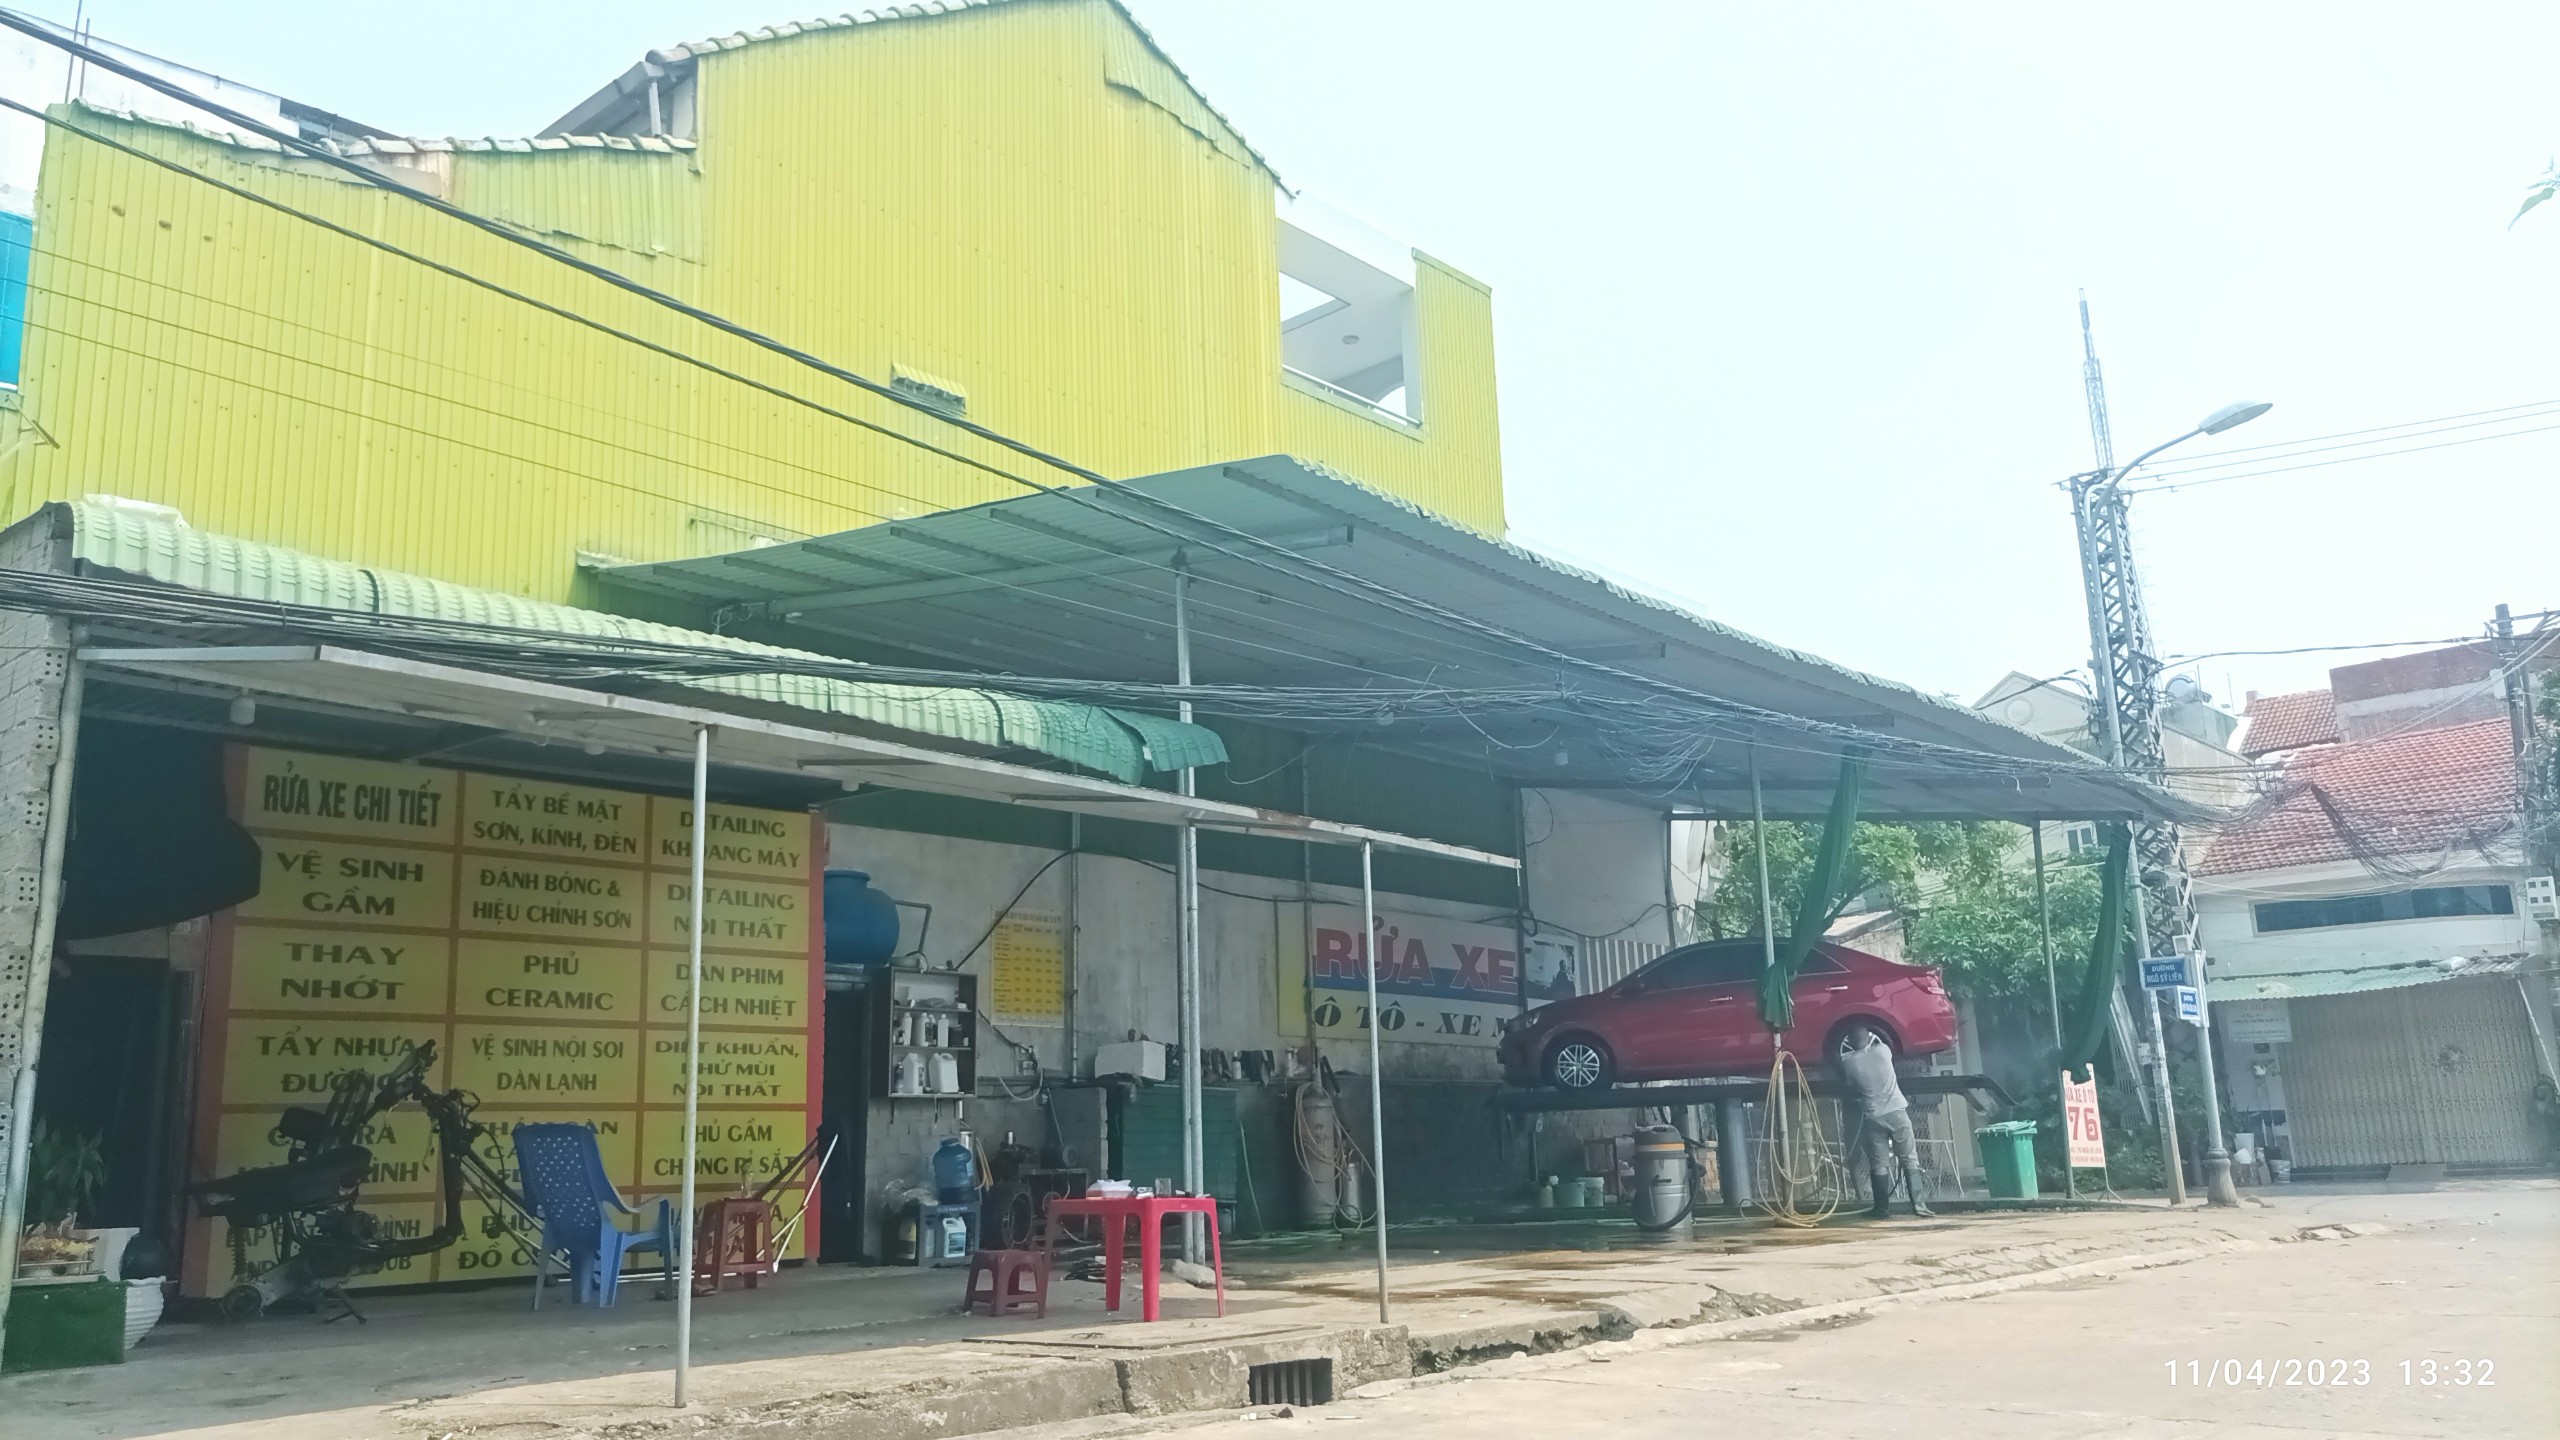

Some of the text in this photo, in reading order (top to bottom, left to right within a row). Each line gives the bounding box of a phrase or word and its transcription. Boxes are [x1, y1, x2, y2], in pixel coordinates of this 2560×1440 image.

[264, 761, 441, 827] RỬA XE CHI TIẾT
[492, 783, 536, 811] TẨY
[577, 799, 622, 823] MẶT
[473, 821, 637, 854] SƠN, KÍNH, ĐÈN
[681, 811, 786, 838] DTAILING
[277, 850, 424, 882] VỆ SINH
[662, 839, 800, 868] KHANG MÁY
[480, 866, 621, 897] ĐÁNH BÓNG &
[302, 886, 395, 915] GẦM
[473, 898, 632, 928] HIỆU CHỈNH SƠN
[725, 916, 787, 940] THẤT
[283, 943, 405, 965] THAY
[523, 951, 579, 975] PHỦ
[1316, 916, 1518, 995] RỬA XE
[281, 975, 405, 1000] NHỚT
[731, 967, 784, 985] PHIM
[485, 987, 614, 1011] CERAMIC
[735, 995, 797, 1021] NHIỆT
[1314, 996, 1341, 1027] Ô
[1356, 1000, 1405, 1031] TÔ
[1435, 1012, 1481, 1036] XE
[256, 1025, 324, 1056] TẨY
[472, 1034, 623, 1063] VỆ SINH NỘI SOI
[681, 1059, 775, 1075] HỬ MÙI
[497, 1069, 597, 1096] DÀN LẠNH
[721, 1080, 781, 1096] THẤT
[681, 1117, 772, 1142] HỦ GẦM
[2068, 1106, 2099, 1141] 76
[458, 1241, 503, 1269] ĐỒ
